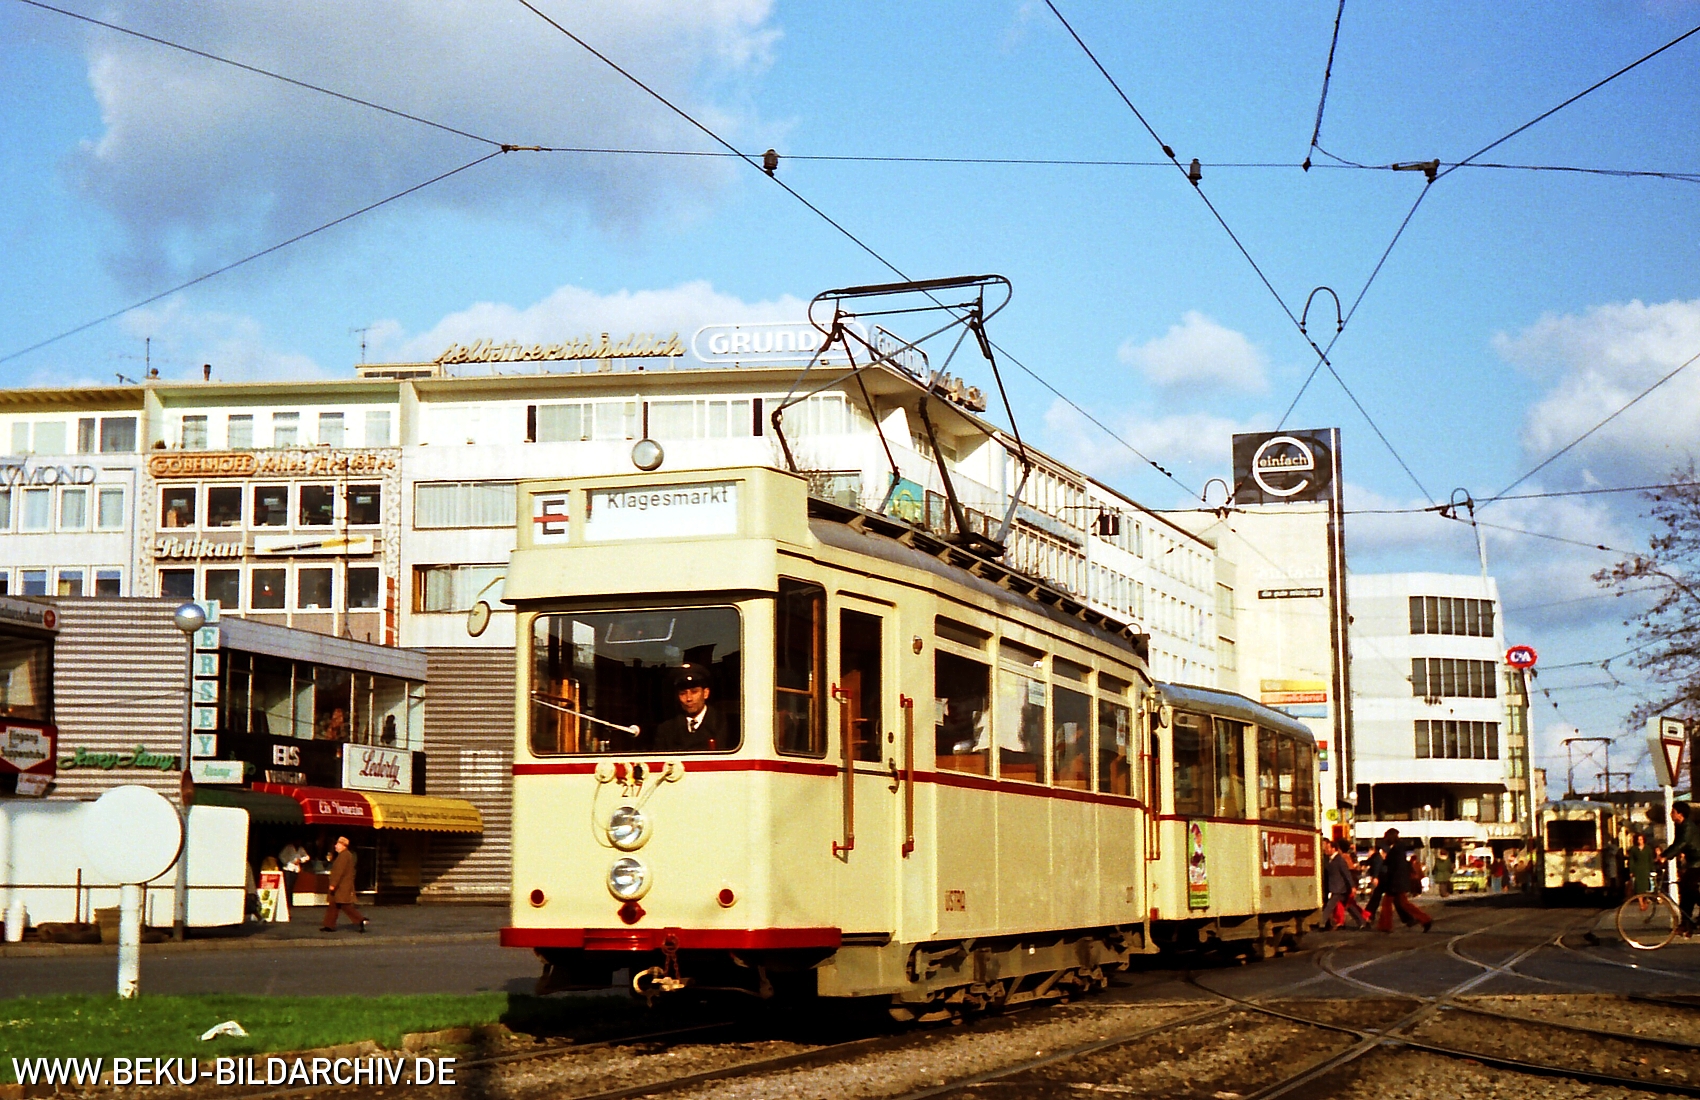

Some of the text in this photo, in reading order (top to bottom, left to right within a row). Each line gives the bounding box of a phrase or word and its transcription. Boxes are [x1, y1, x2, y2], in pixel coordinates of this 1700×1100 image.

[1259, 452, 1308, 467] einfach
[0, 465, 97, 493] YMOND
[607, 488, 729, 511] Klagesmarkt
[154, 537, 246, 559] Pelikan
[199, 602, 215, 755] JERSEY
[273, 744, 300, 766] EIS
